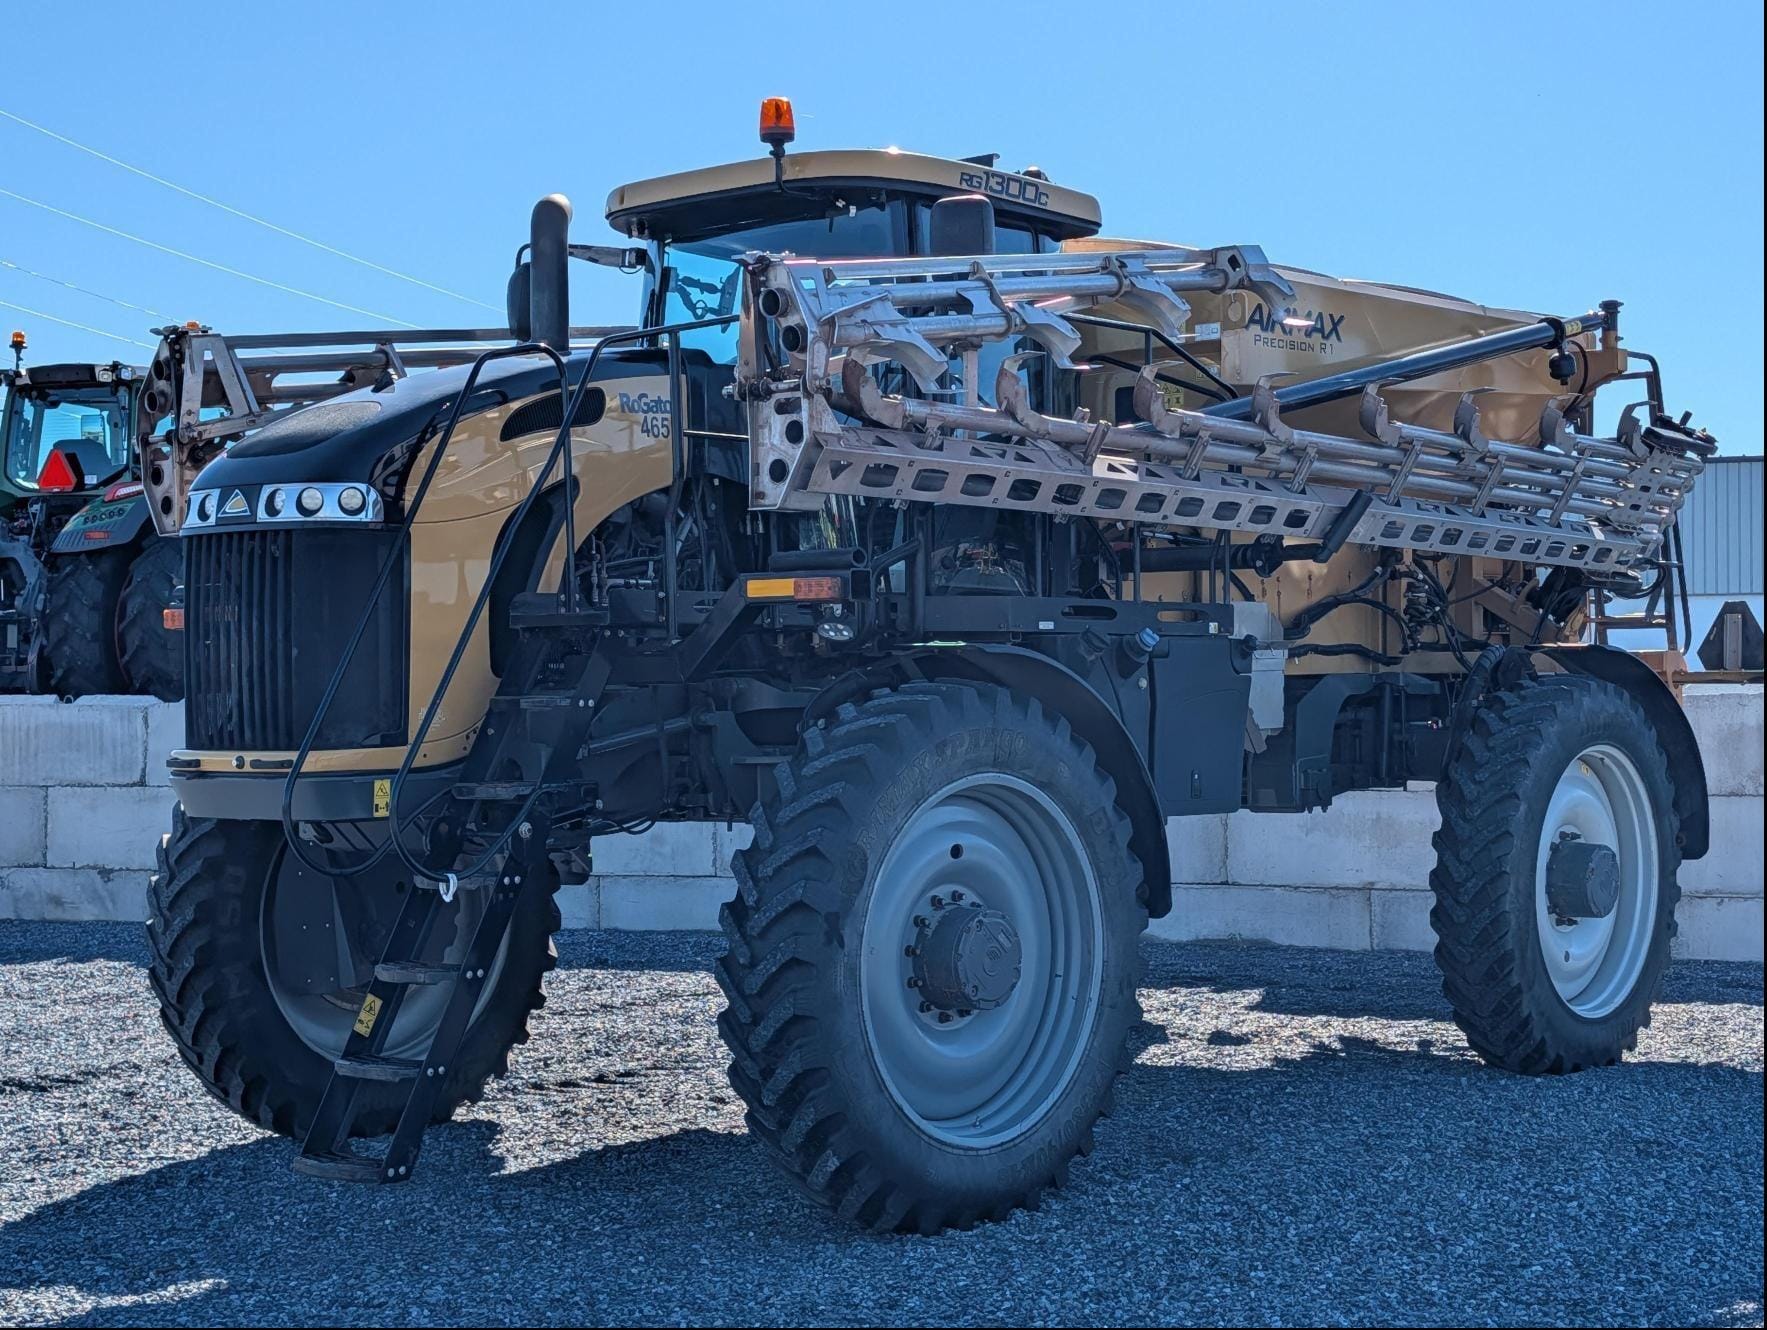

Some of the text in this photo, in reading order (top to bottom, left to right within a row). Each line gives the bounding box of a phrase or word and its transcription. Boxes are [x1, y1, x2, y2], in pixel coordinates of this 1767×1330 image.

[1254, 334, 1315, 353] PRECISION
[619, 392, 672, 414] RoGato
[640, 415, 670, 438] 465
